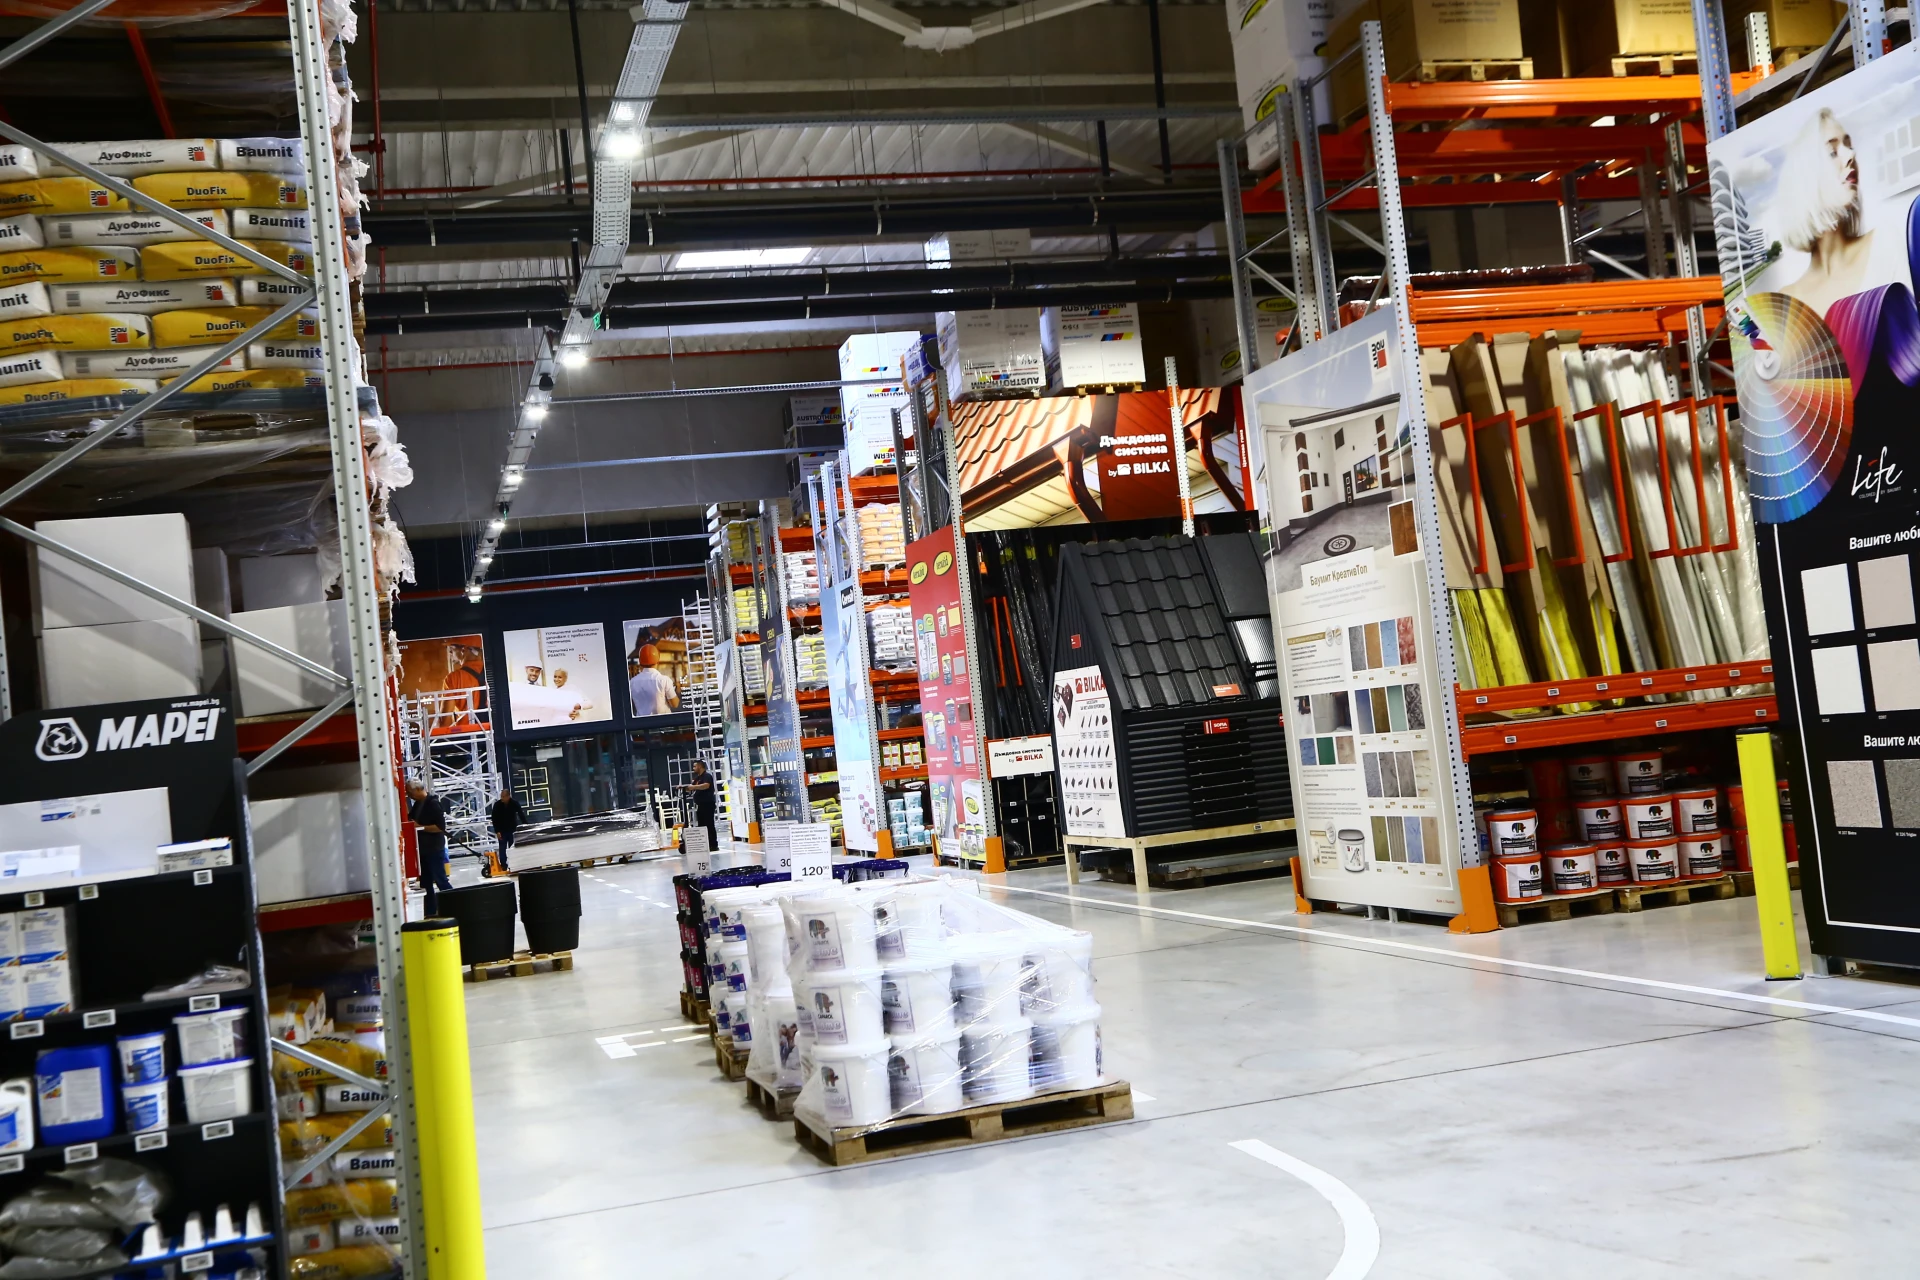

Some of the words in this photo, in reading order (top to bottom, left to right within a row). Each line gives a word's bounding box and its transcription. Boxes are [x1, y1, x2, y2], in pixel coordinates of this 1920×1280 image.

[236, 146, 293, 158] Baumit
[186, 186, 227, 196] DuoFix
[249, 214, 306, 229] Baumit
[195, 255, 235, 265] DuoFix
[2, 262, 43, 275] DuoFix
[206, 320, 247, 331] DuoFix
[13, 330, 54, 342] DuoFix
[265, 346, 322, 359] Baumit
[213, 379, 252, 391] DuoFix
[24, 390, 68, 403] DuoFix
[1099, 432, 1167, 447] Дъждовна
[1114, 444, 1168, 457] система
[1133, 462, 1170, 474] BILKA
[1851, 446, 1903, 503] Life
[1849, 535, 1892, 550] Вашите
[1310, 574, 1331, 587] Баумит
[1332, 564, 1368, 582] КреативТоп
[1084, 676, 1107, 693] BILKA
[171, 698, 220, 708] www.mapei.bg
[96, 707, 220, 752] MAPEI
[1863, 735, 1905, 748] Вашите
[801, 866, 823, 877] 120
